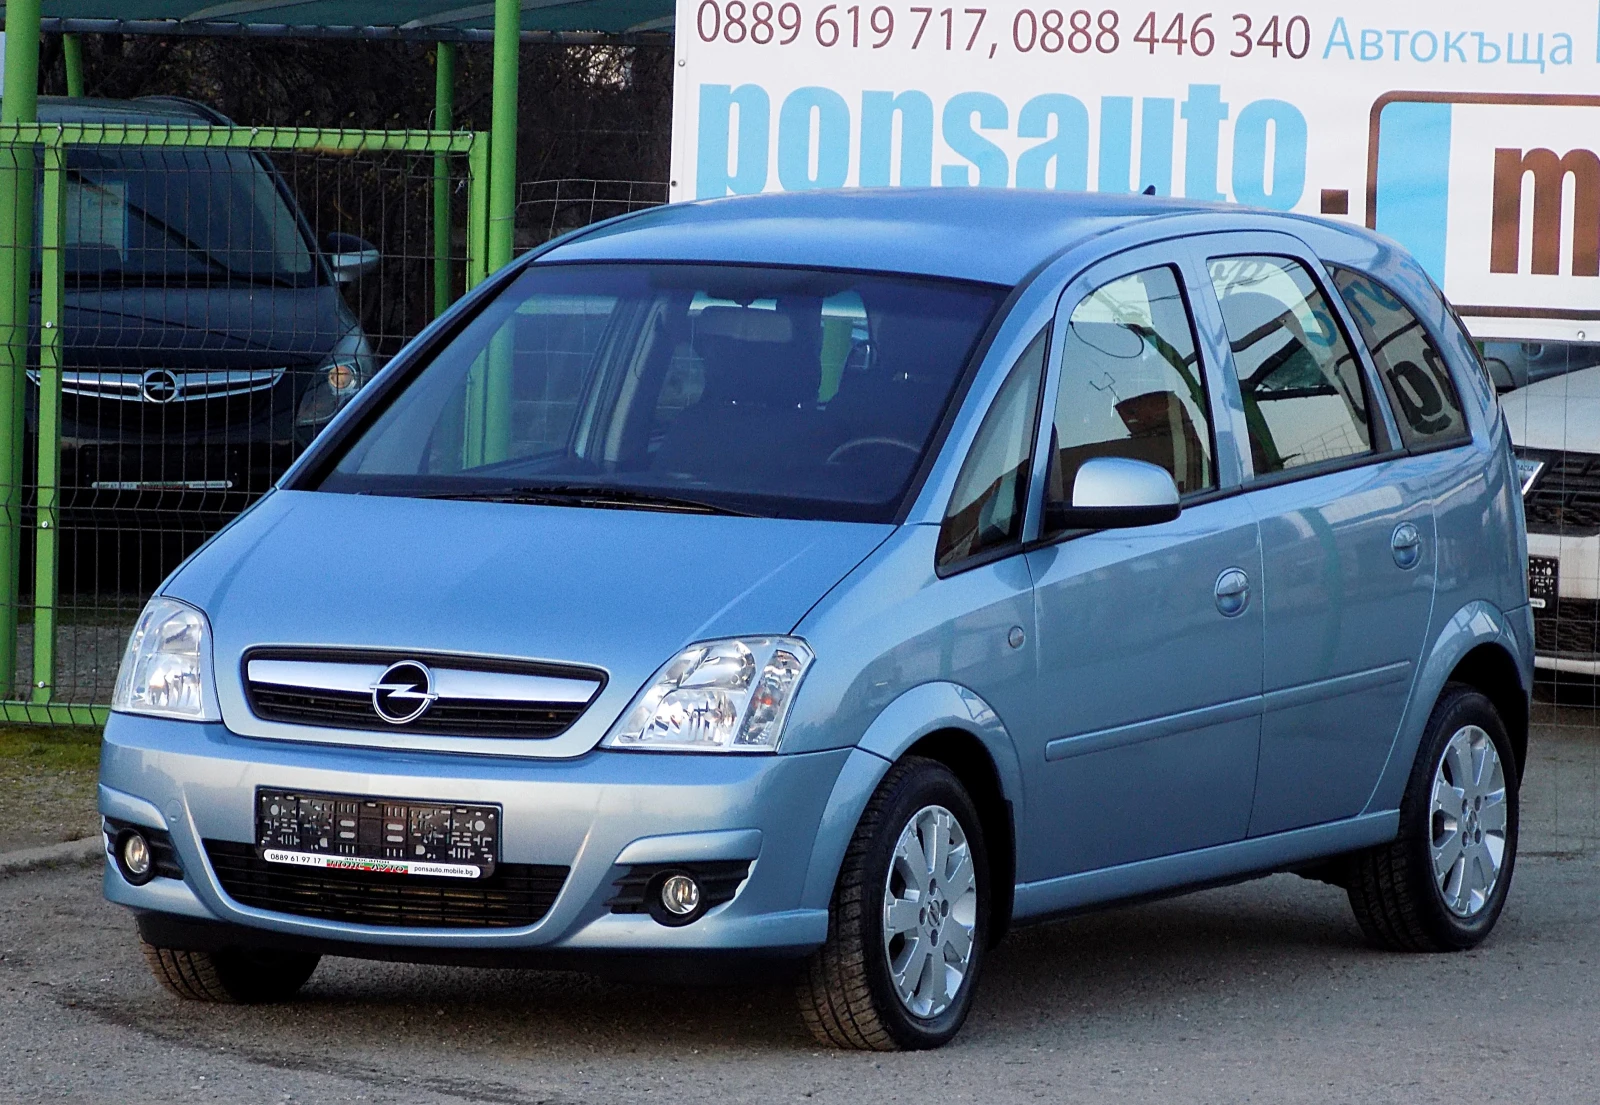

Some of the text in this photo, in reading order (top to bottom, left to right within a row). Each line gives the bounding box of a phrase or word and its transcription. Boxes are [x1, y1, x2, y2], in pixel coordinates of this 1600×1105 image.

[696, 0, 1311, 60] 0889 619 717, 0888 446 340
[1322, 16, 1574, 74] Автокъща
[270, 853, 289, 861] 0889
[414, 866, 474, 876] ponsauto.mobile.bg
